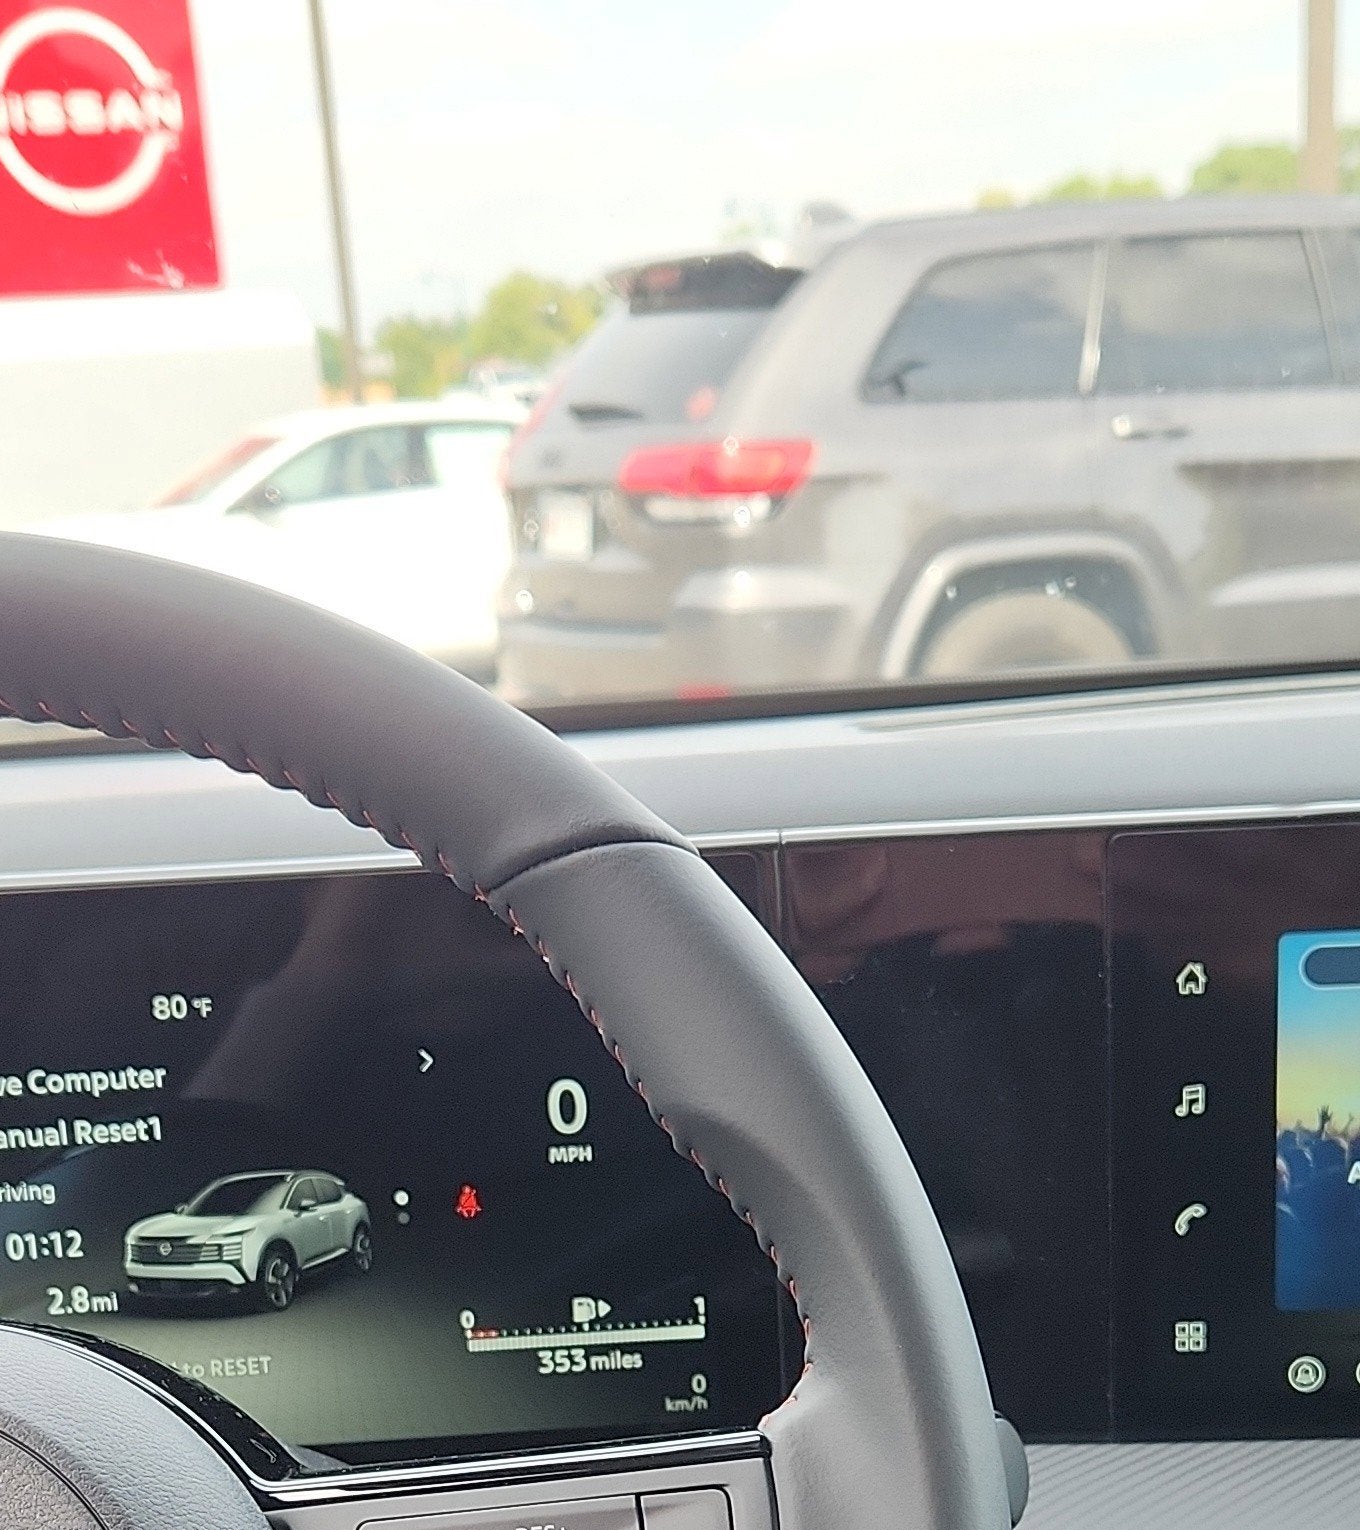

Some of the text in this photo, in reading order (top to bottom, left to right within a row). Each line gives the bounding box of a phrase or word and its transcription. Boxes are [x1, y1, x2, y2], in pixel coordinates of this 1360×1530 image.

[151, 994, 188, 1020] 80
[27, 1066, 167, 1097] Computer
[547, 1078, 588, 1135] 0
[548, 1145, 593, 1164] MPH
[5, 1229, 84, 1261] 01:12
[693, 1296, 706, 1315] 1
[459, 1310, 475, 1330] 0
[210, 1355, 272, 1378] RESET
[538, 1349, 643, 1374] 353 miles
[691, 1374, 707, 1393] 0
[665, 1396, 709, 1413] km/h
